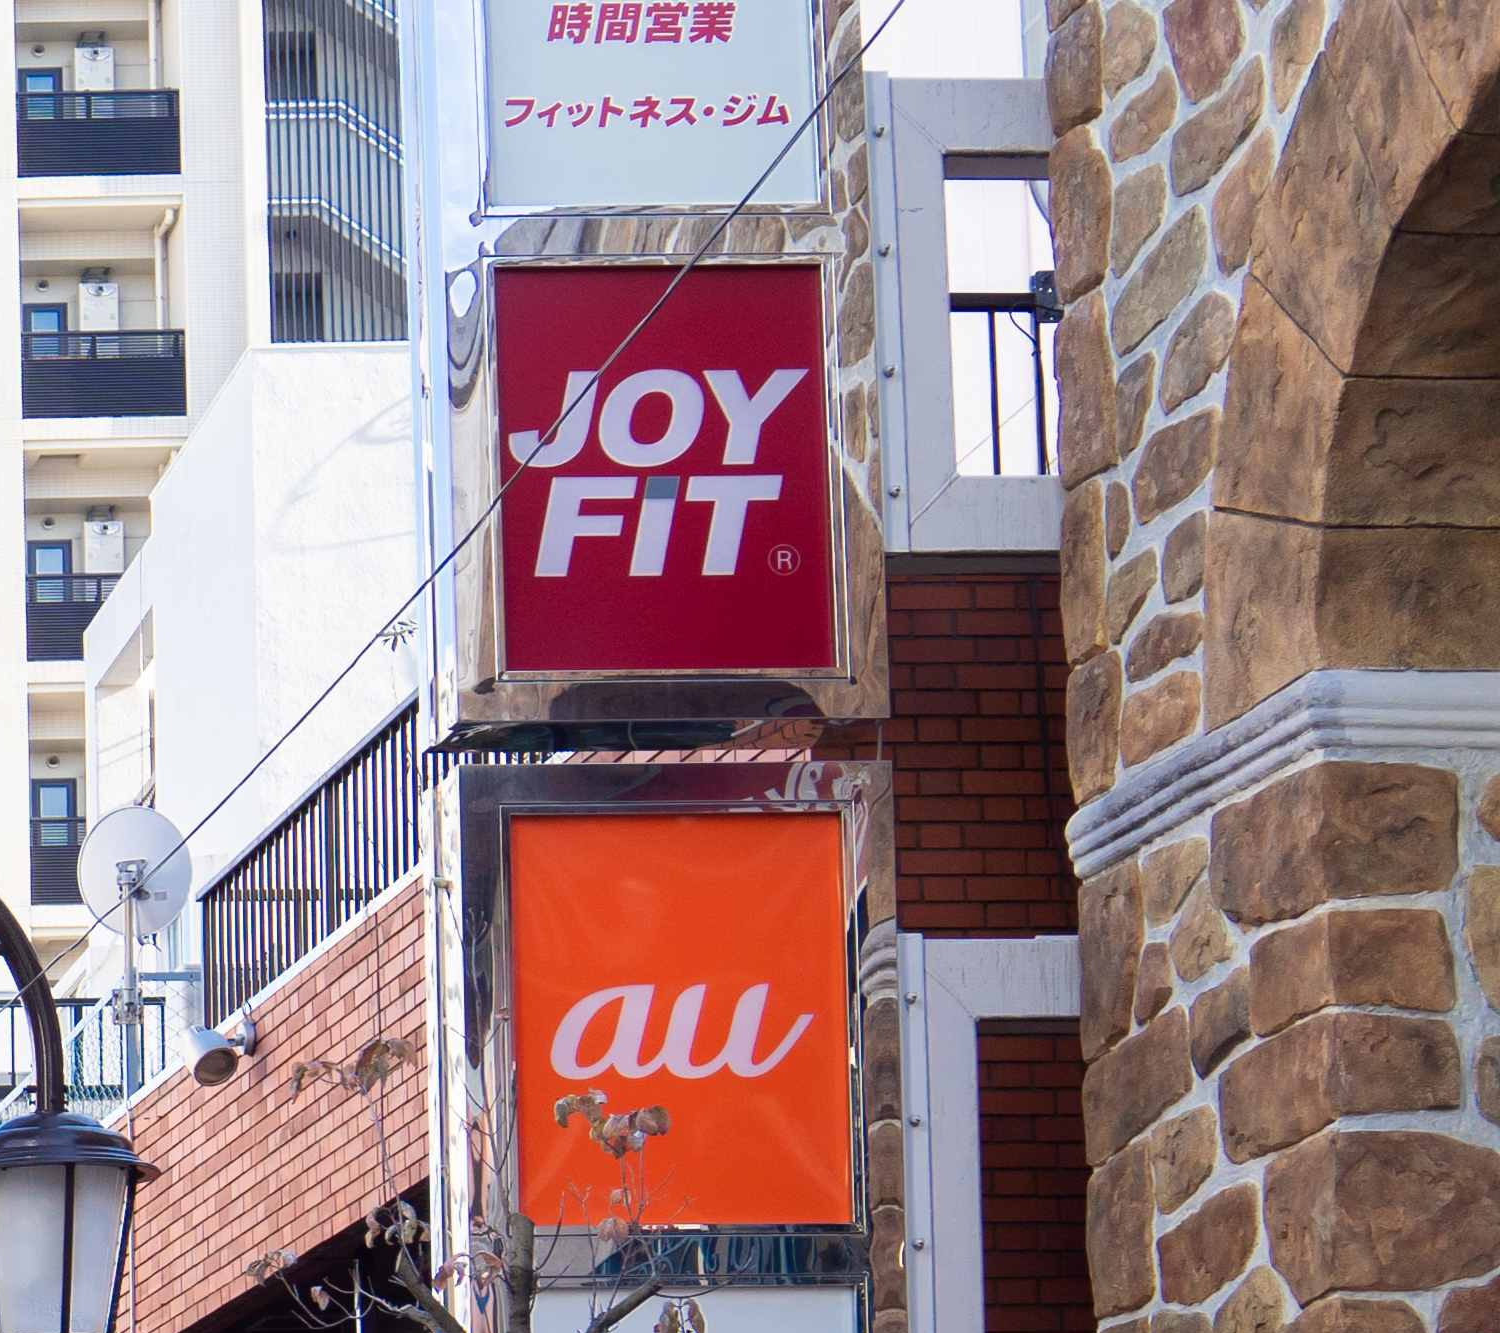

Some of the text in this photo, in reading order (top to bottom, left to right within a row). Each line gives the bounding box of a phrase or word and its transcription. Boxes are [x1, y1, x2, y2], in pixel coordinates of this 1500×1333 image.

[546, 1, 737, 45] 時間営業
[502, 94, 791, 129] フィットネス・ジム
[508, 368, 809, 468] JOY
[534, 475, 783, 577] FIT
[550, 983, 814, 1080] au
